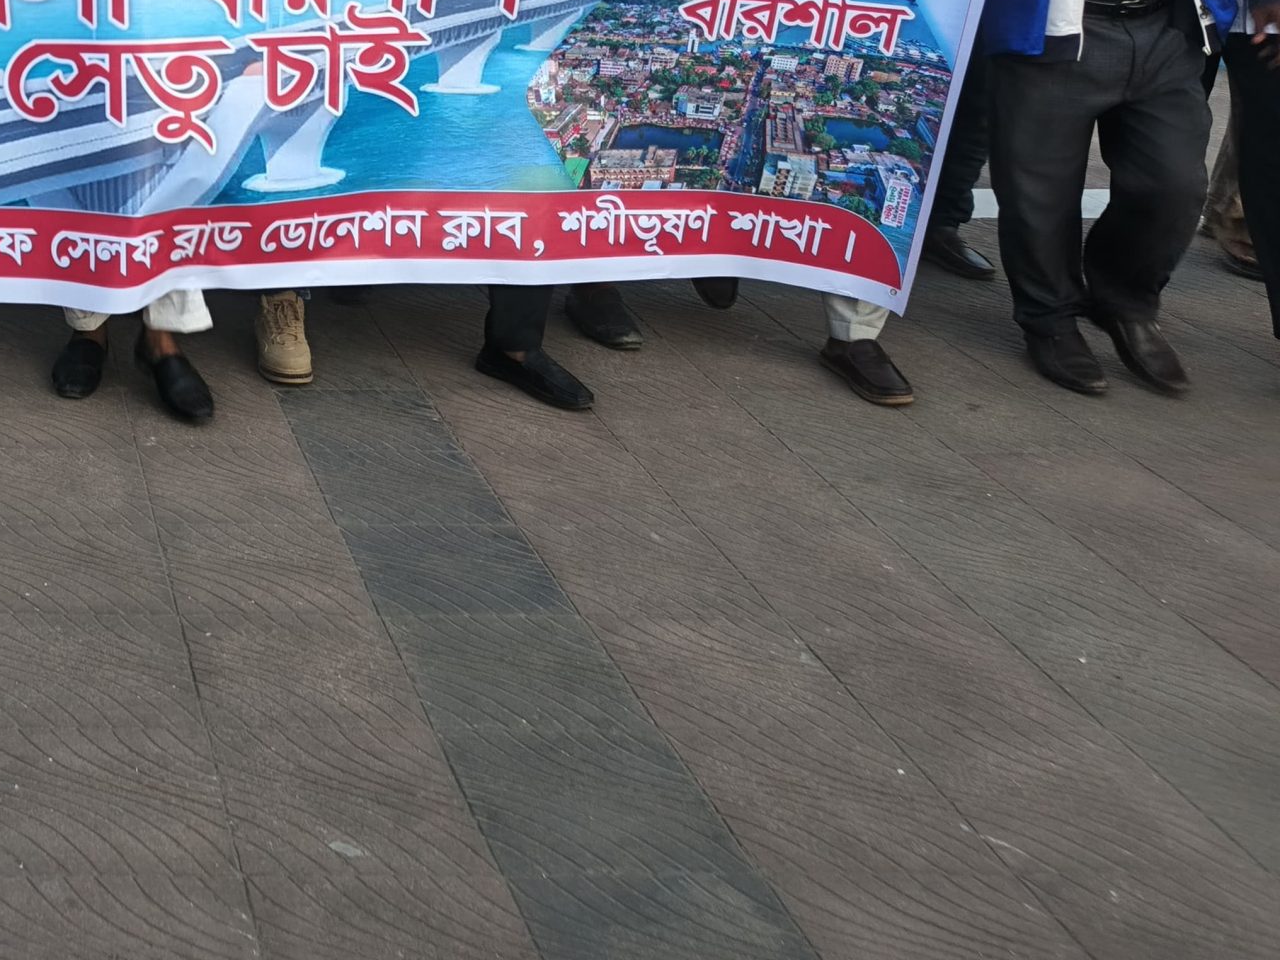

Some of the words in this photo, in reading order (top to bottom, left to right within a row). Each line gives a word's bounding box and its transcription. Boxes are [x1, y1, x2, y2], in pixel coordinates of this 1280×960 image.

[7, 37, 233, 154] সেতু
[248, 3, 429, 116] চাই
[51, 227, 162, 276] সেলফ
[171, 220, 251, 262] ব্লাড
[260, 206, 428, 254] ডোনেশন
[560, 195, 716, 255] শশীভূষণ
[728, 210, 833, 257] শাখা
